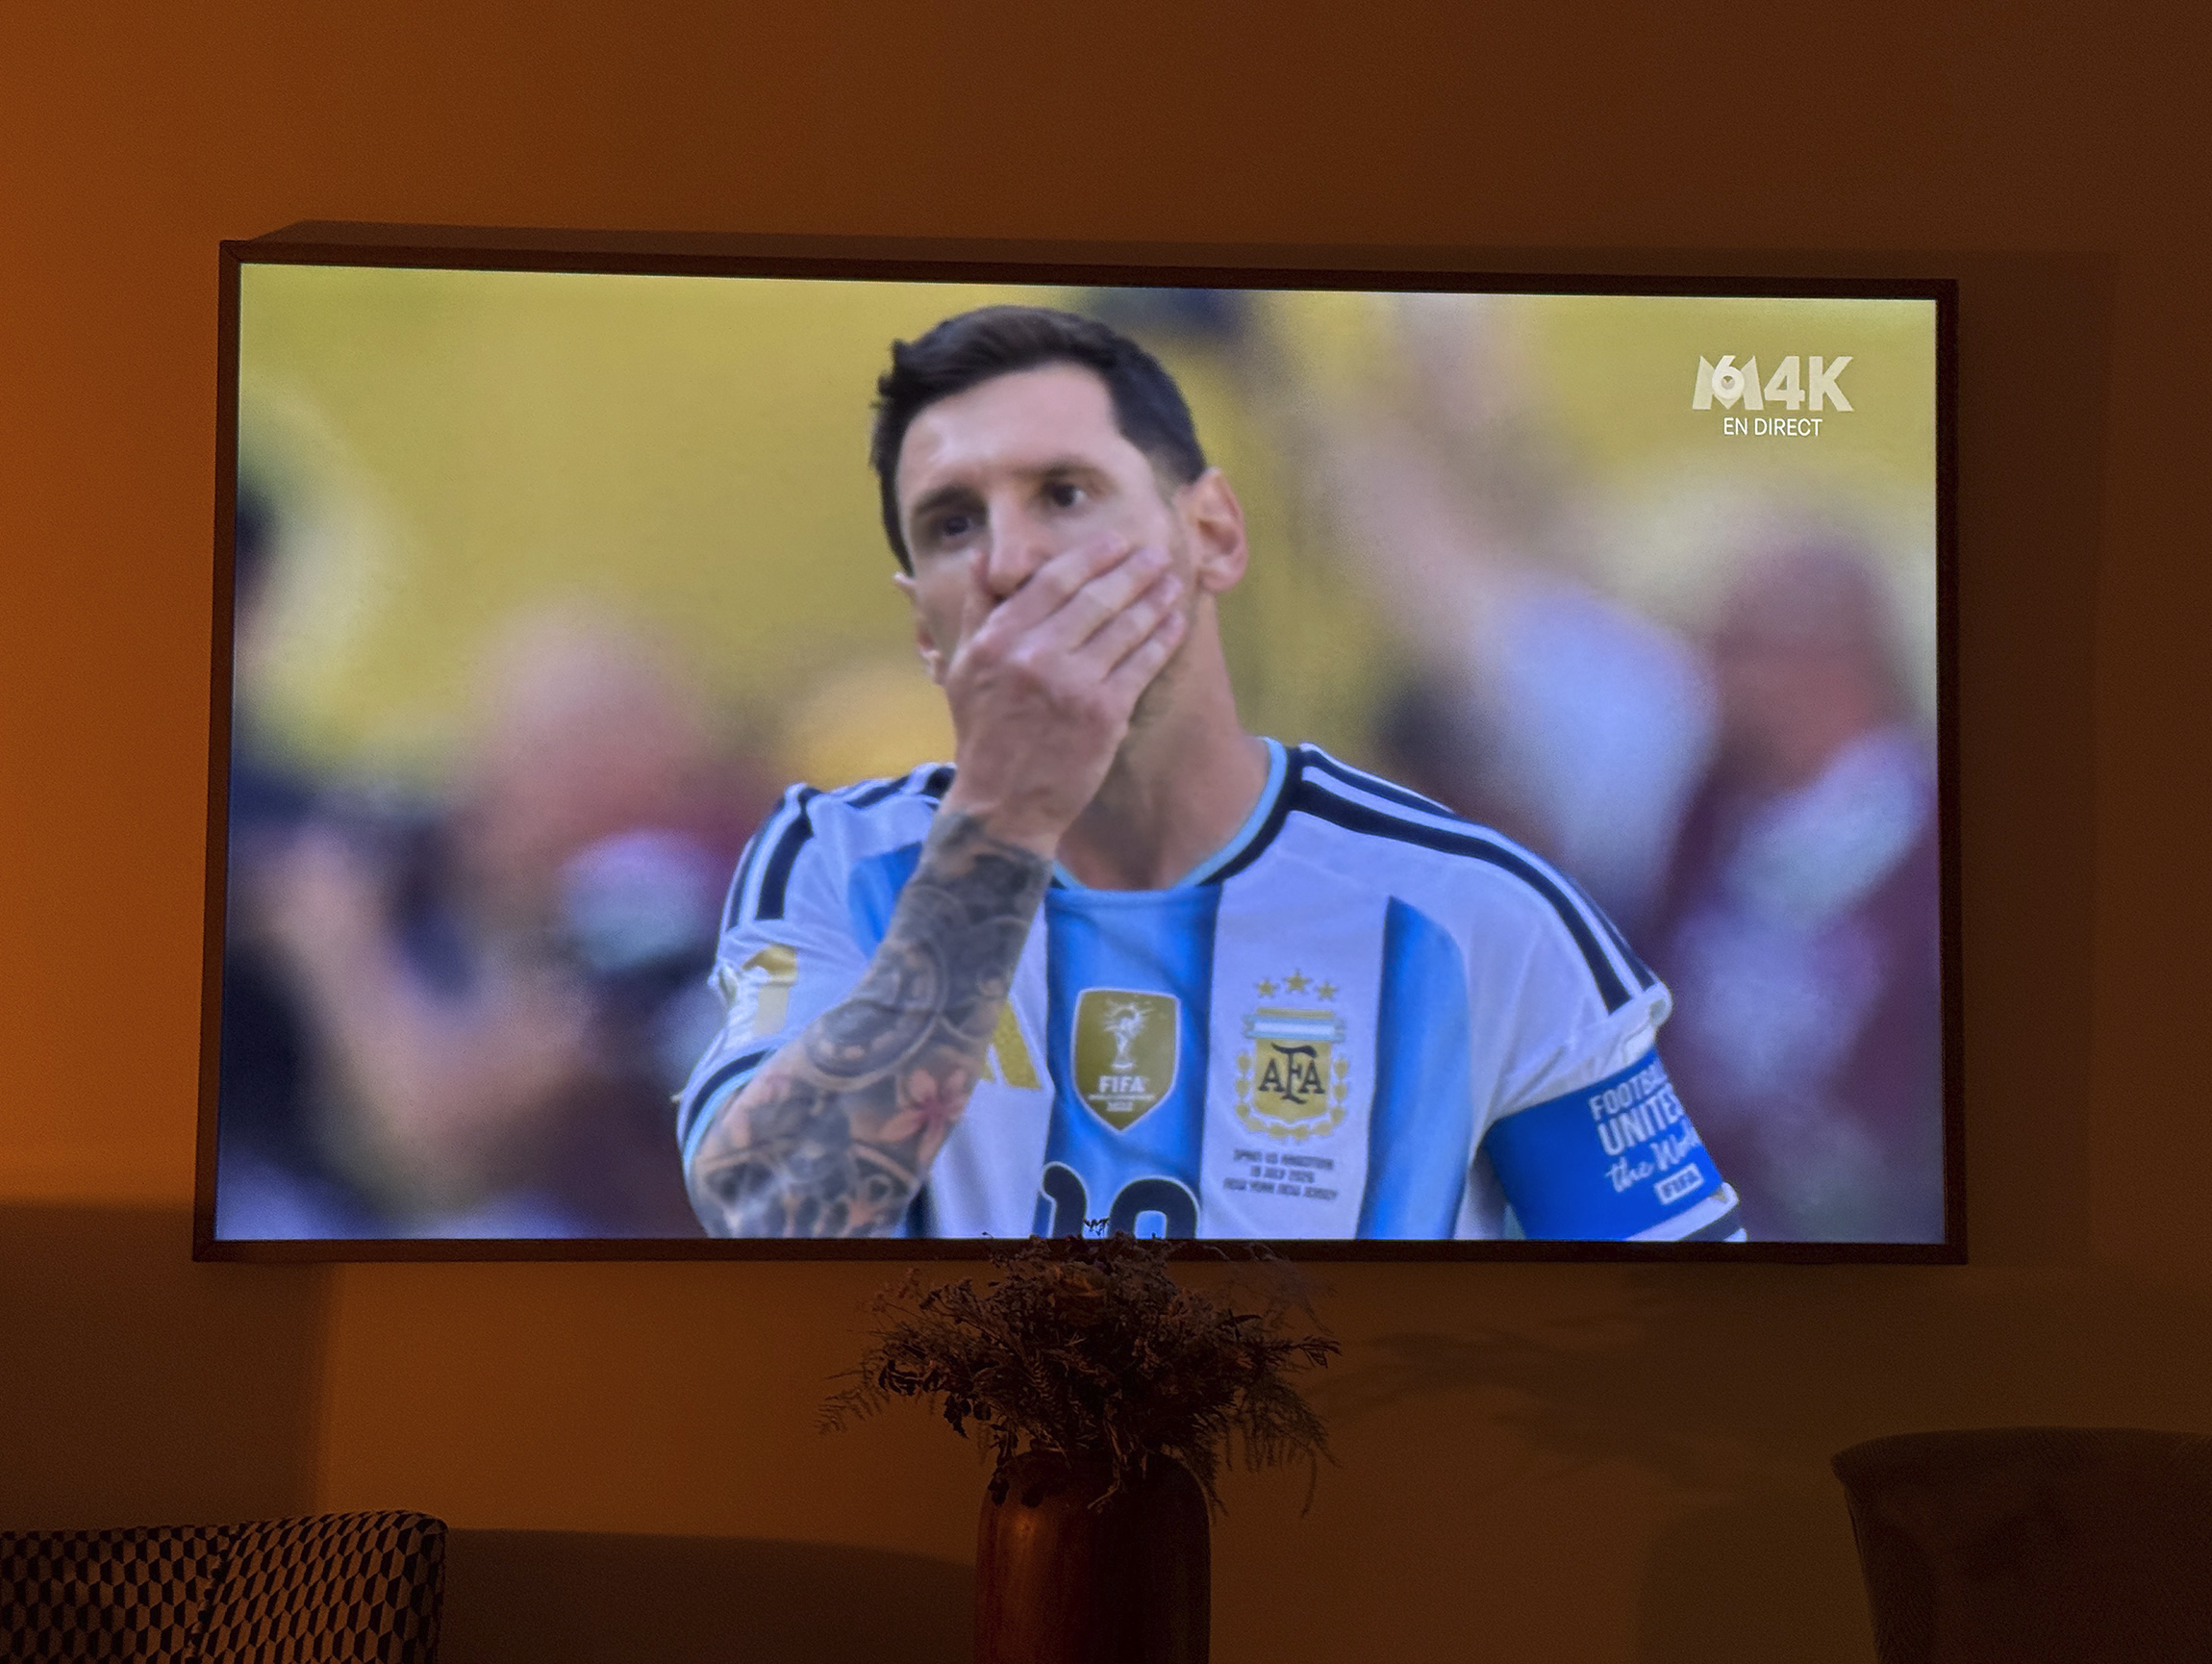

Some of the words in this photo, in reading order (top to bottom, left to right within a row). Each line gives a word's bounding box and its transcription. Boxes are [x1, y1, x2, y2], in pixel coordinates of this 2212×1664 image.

[1723, 417, 1748, 435] EN
[1754, 417, 1823, 437] DIRECT
[1098, 1075, 1146, 1093] FIFA
[1258, 1042, 1325, 1105] AFA
[1605, 1156, 1655, 1193] the
